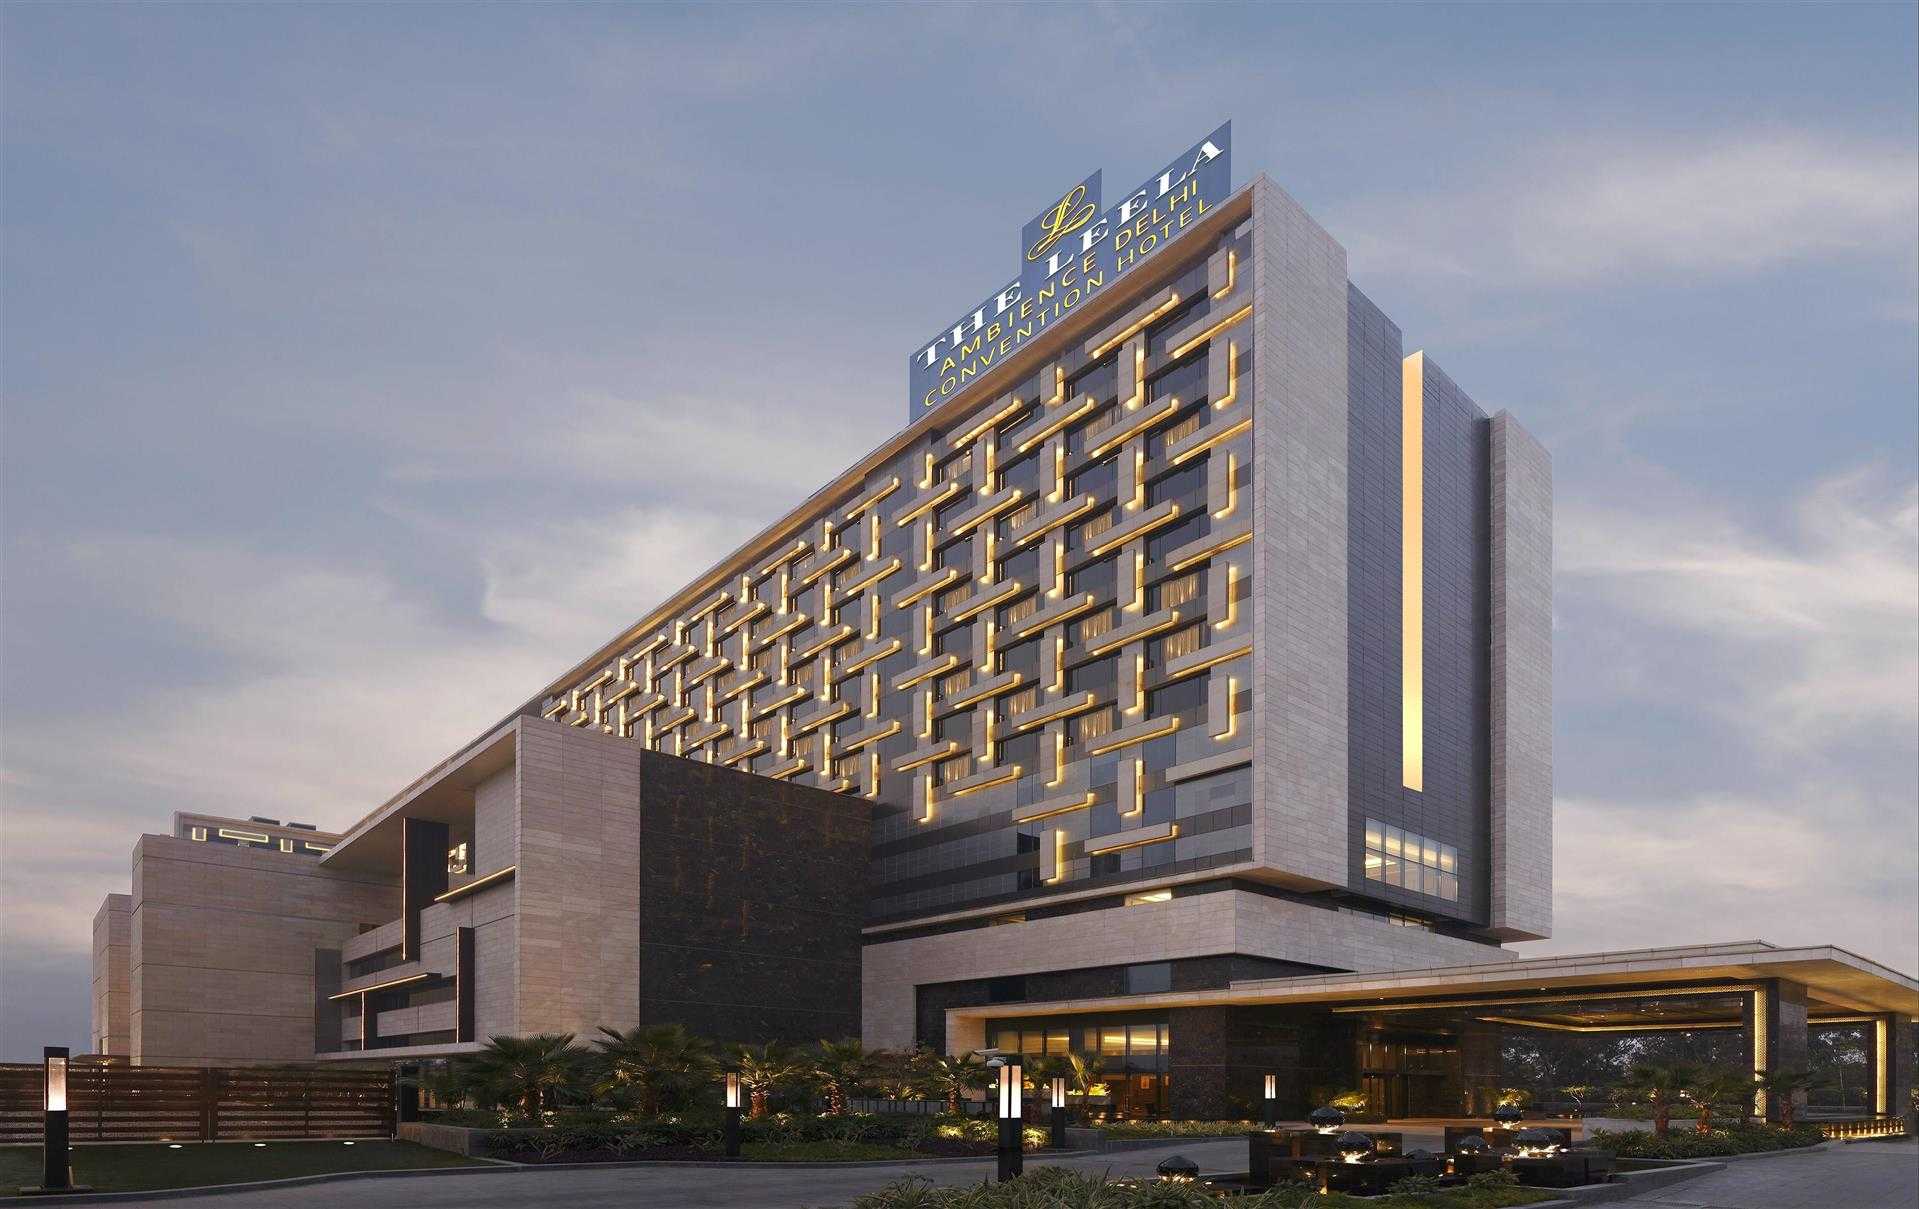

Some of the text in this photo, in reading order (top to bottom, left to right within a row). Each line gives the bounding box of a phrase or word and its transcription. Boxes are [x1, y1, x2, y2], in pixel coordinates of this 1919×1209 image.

[917, 140, 1224, 370] THE LEELA
[924, 200, 1213, 407] CONVENTION HOTEL
[940, 179, 1197, 377] AMBIENCE DELHI
